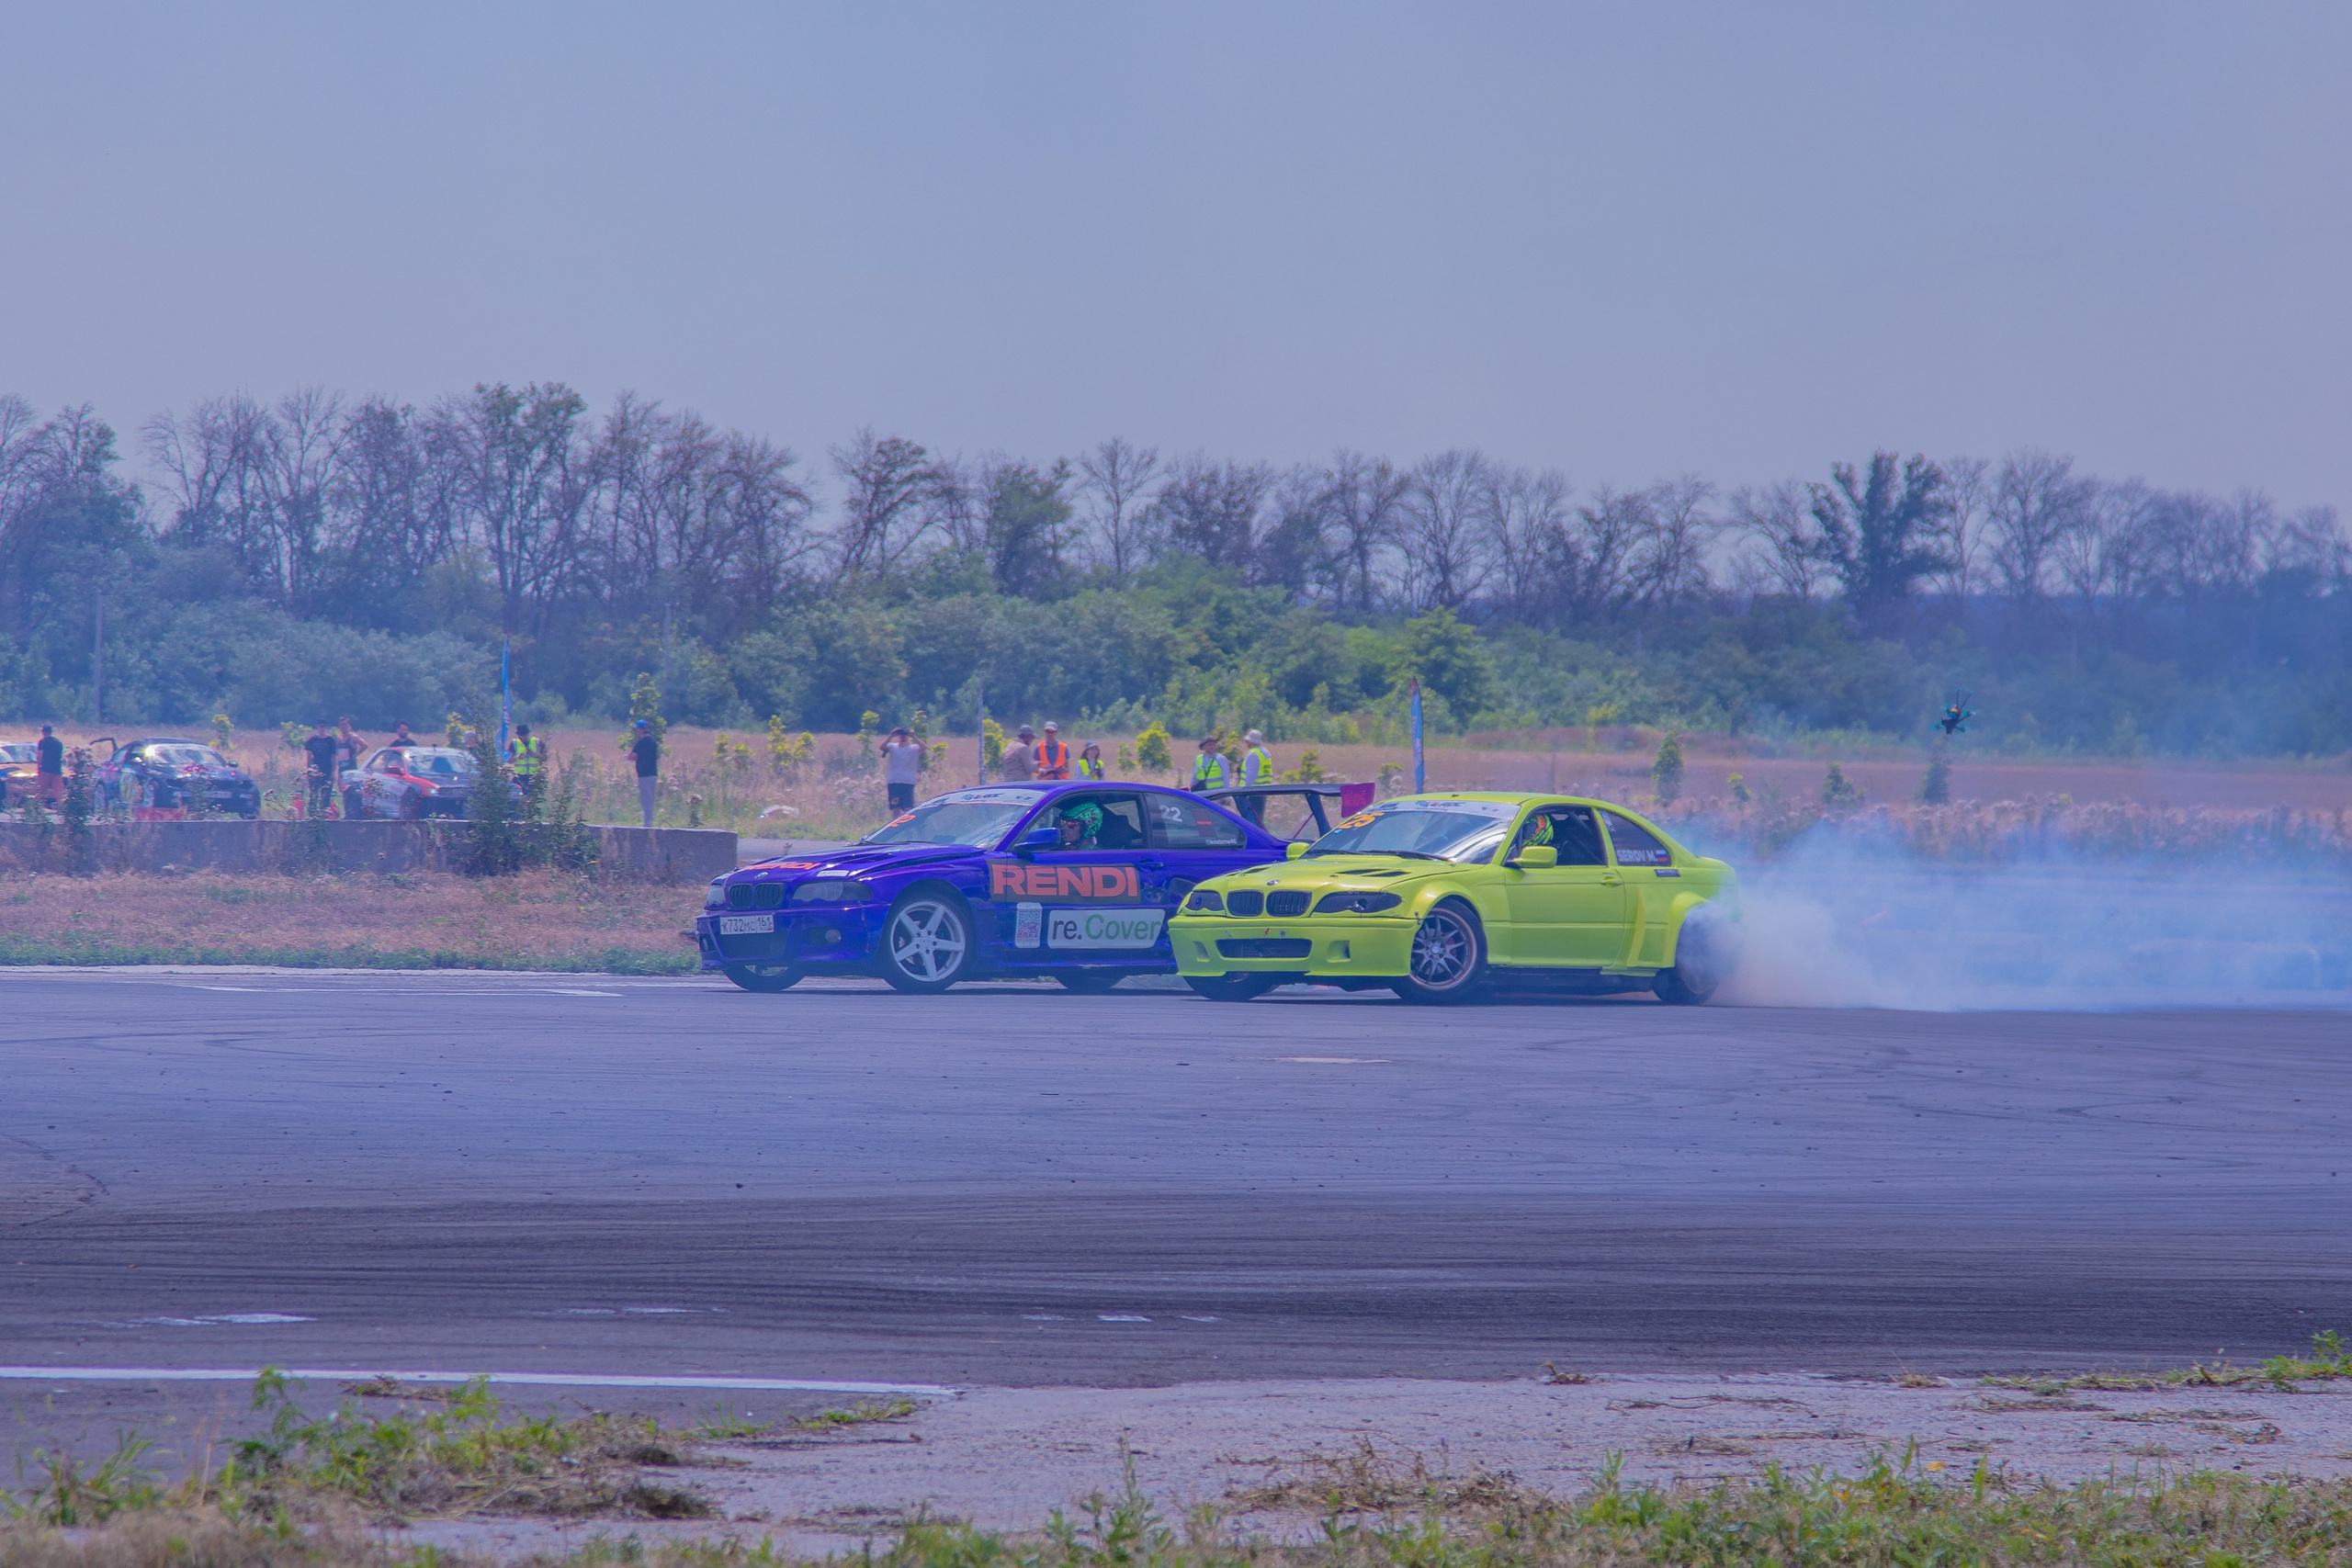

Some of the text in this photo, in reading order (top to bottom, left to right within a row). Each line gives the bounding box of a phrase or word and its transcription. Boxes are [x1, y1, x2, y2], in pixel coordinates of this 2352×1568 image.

[1159, 805, 1182, 822] 22
[1338, 812, 1385, 829] 25
[1617, 850, 1646, 862] SEROV
[991, 863, 1138, 897] RENDI
[757, 917, 772, 927] 161
[1053, 914, 1161, 940] re.Cover
